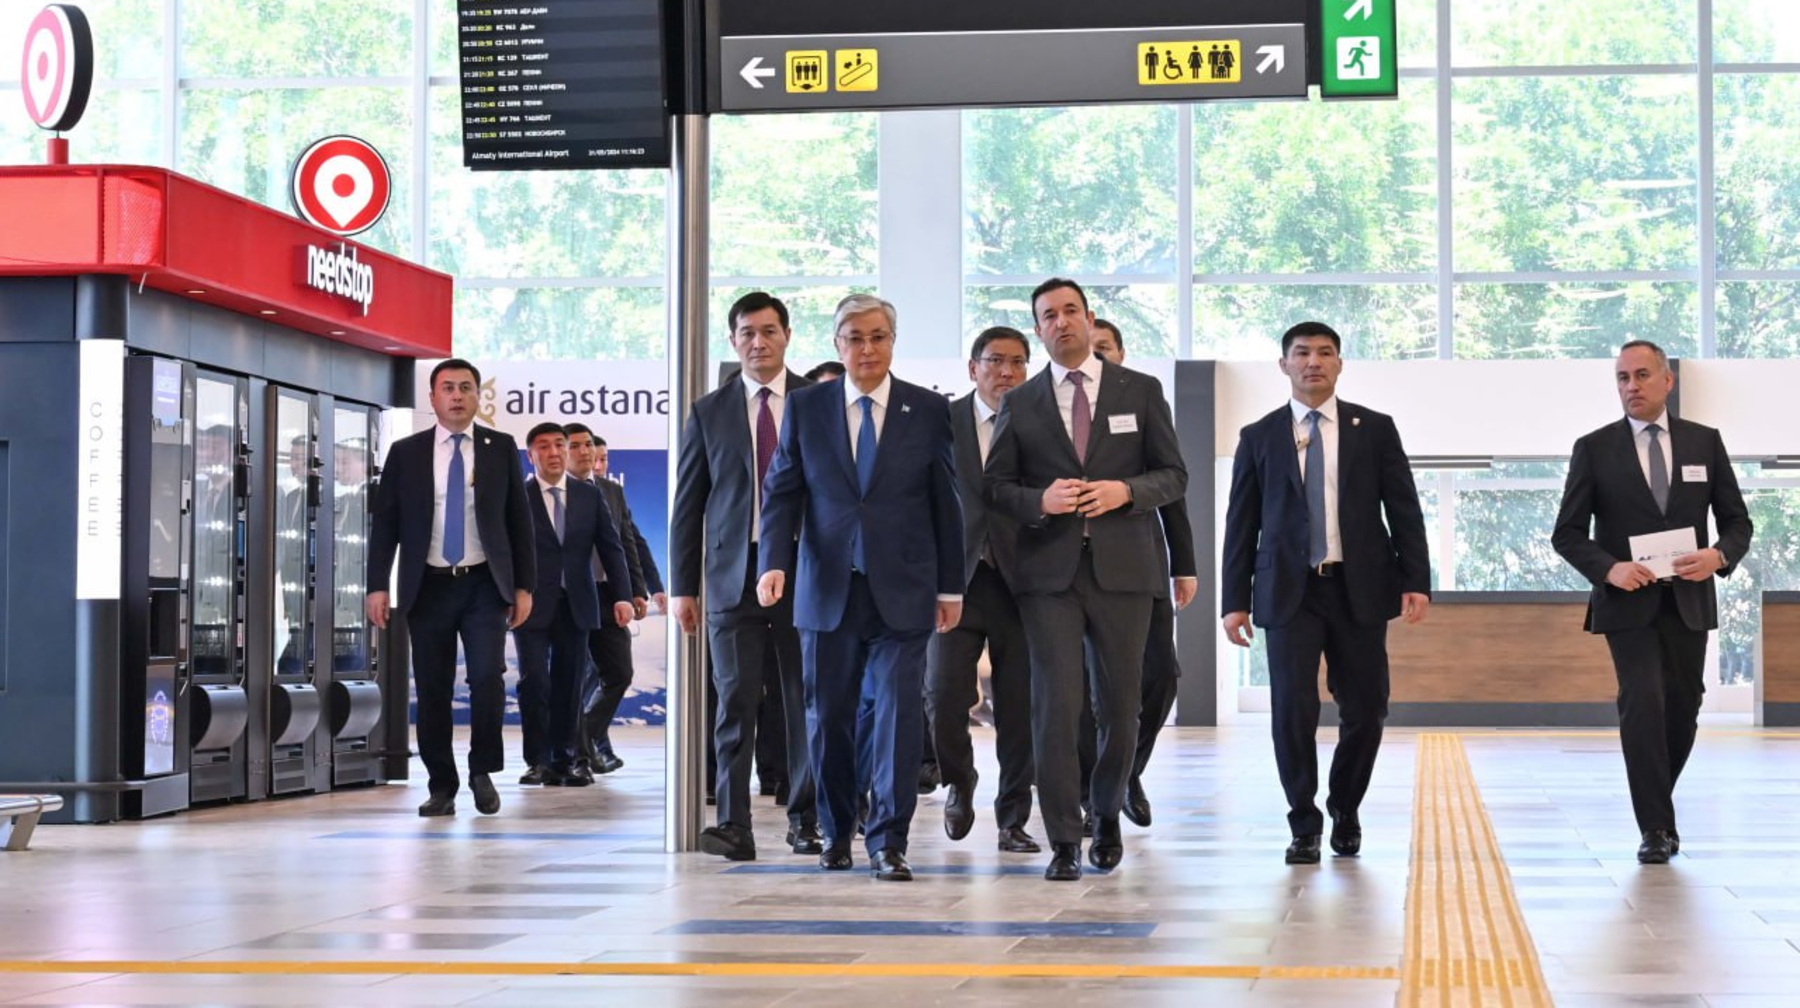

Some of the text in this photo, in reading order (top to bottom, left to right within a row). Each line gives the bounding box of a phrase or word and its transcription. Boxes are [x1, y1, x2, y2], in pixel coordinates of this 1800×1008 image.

[472, 150, 569, 160] Almaty International Airport
[307, 241, 373, 318] needstop
[506, 381, 669, 415] air astana
[88, 402, 103, 536] COFFEE
